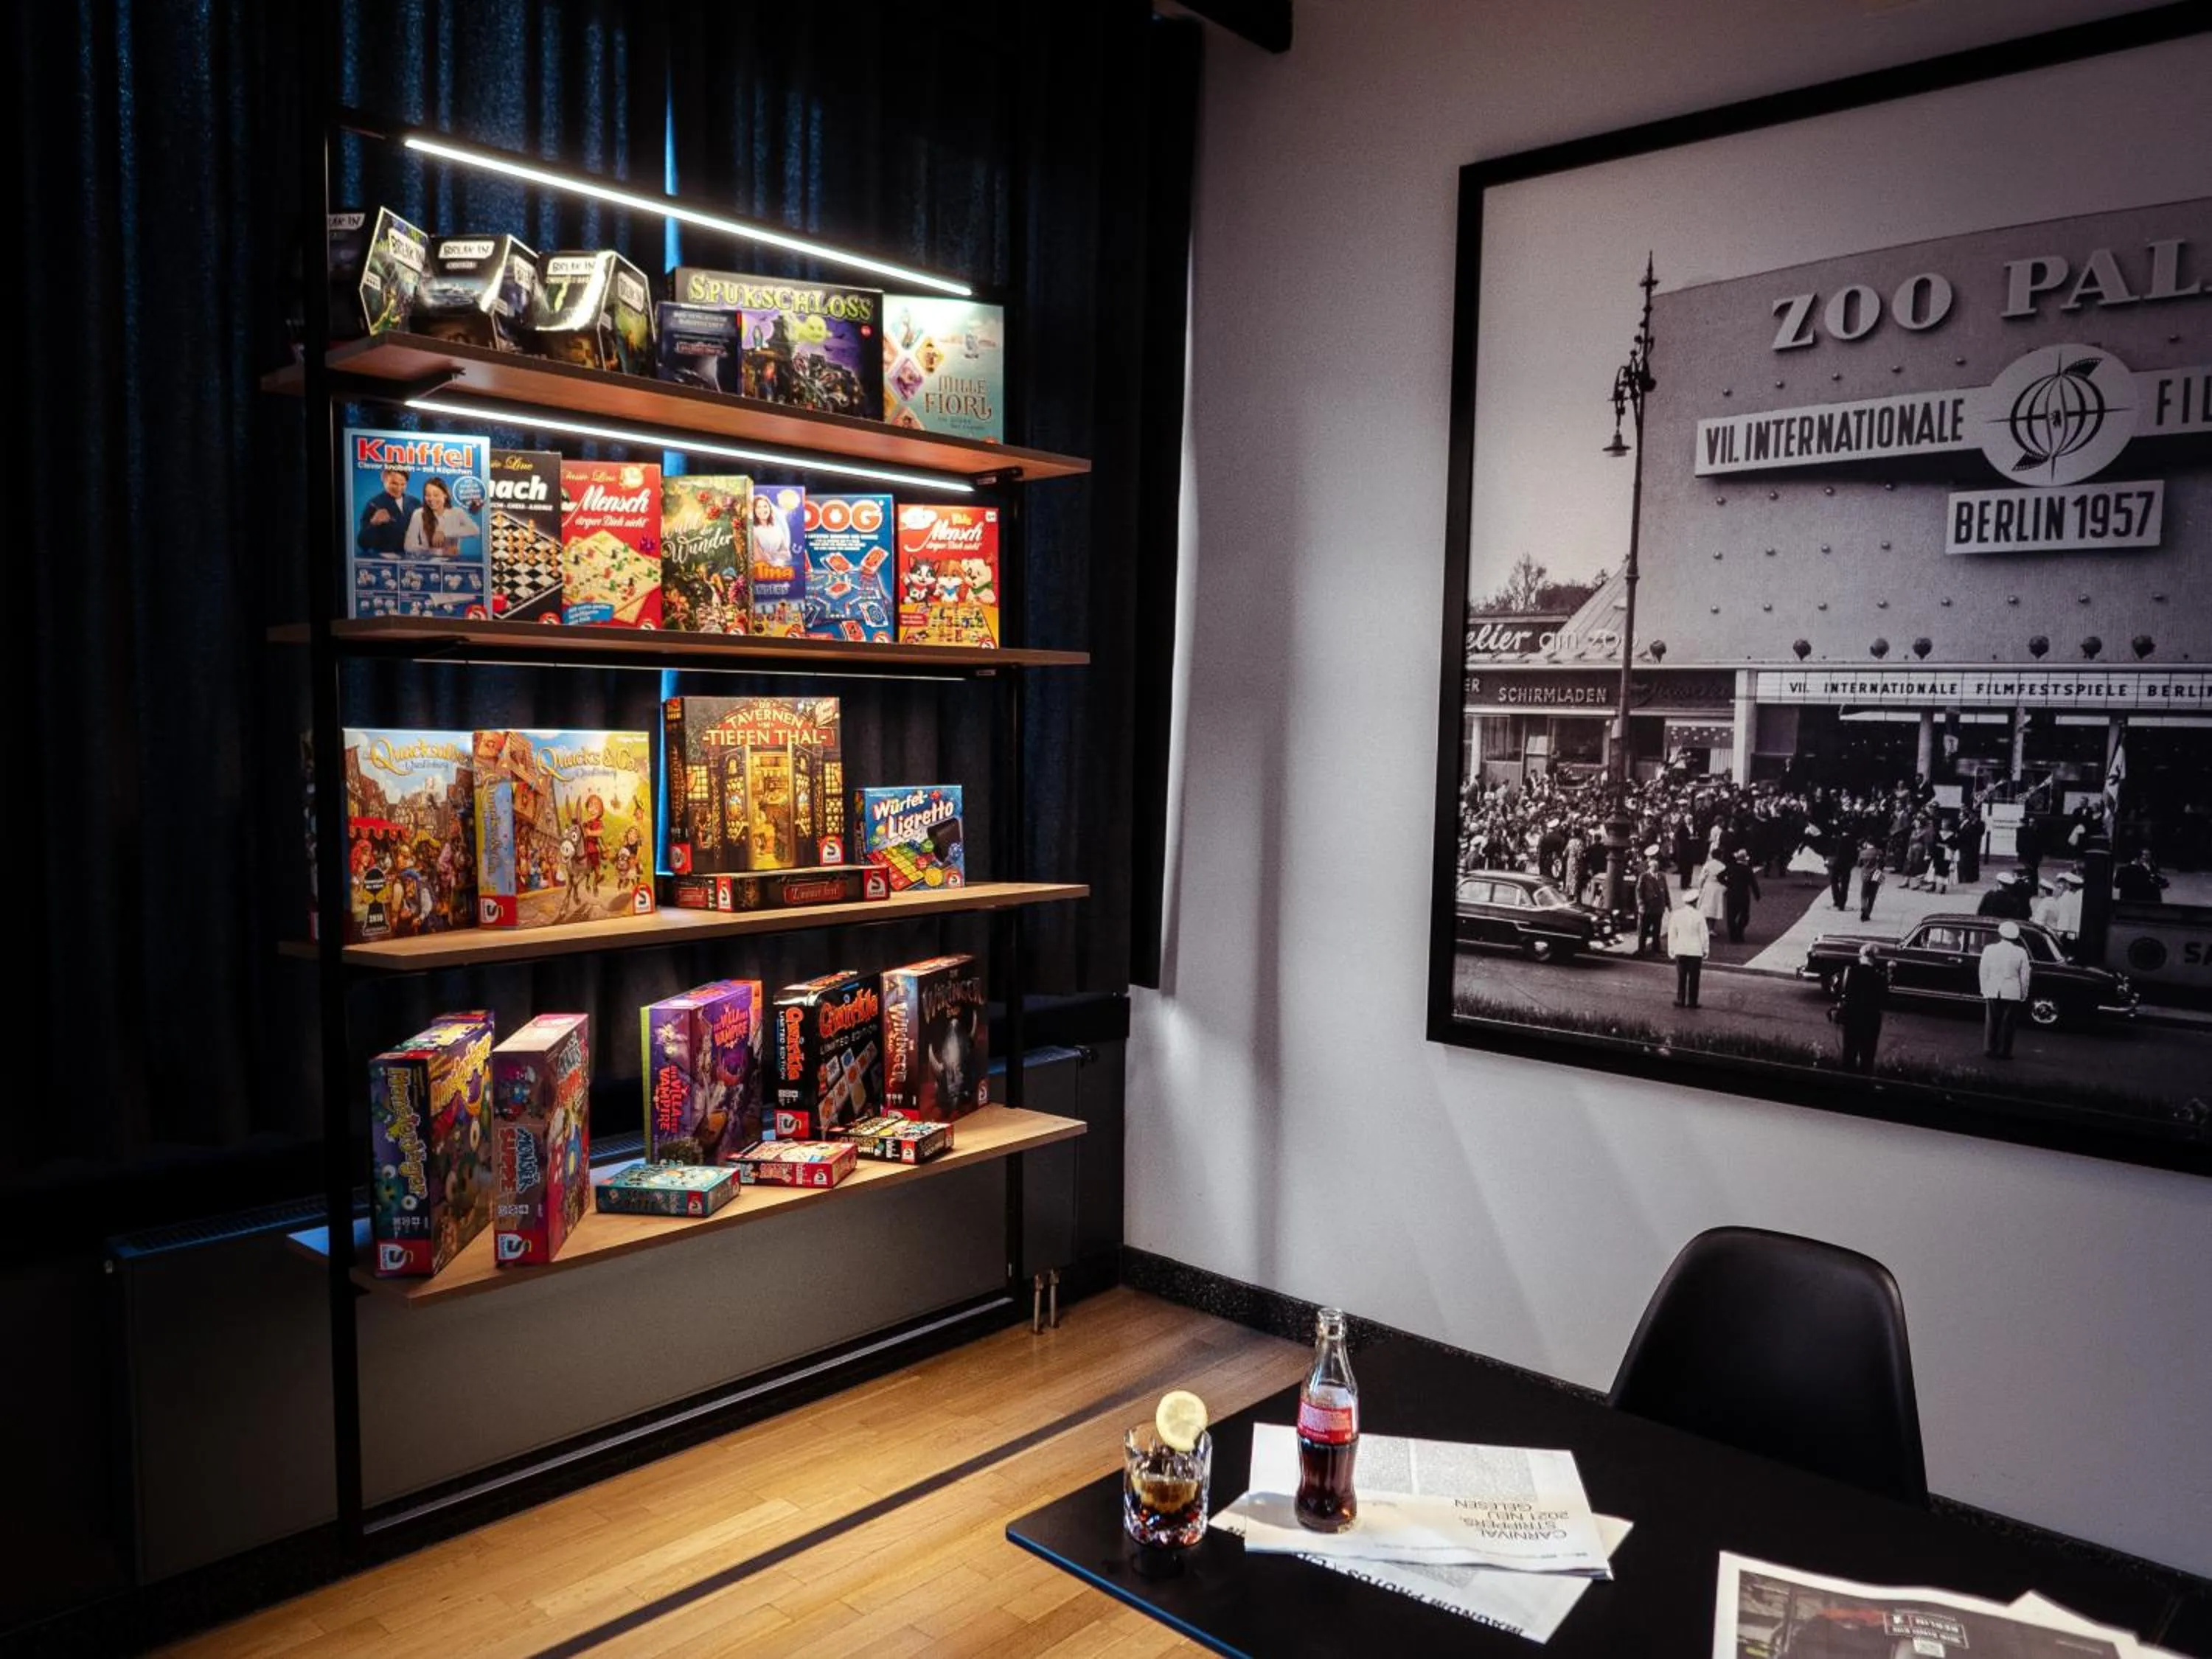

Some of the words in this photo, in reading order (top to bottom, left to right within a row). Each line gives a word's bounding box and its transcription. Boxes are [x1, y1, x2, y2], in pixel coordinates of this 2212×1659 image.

[1771, 272, 1954, 351] ZOO
[2001, 238, 2202, 319] PAL
[1705, 422, 1741, 466] VII.
[1744, 397, 1964, 462] INTERNATIONALE
[2156, 375, 2212, 425] FIL
[358, 437, 473, 468] Kniffel
[572, 484, 651, 516] Mensch
[804, 499, 883, 533] DOG
[1954, 497, 2066, 545] BERLIN
[2073, 491, 2155, 538] 1957
[661, 527, 734, 564] Wunder
[755, 562, 794, 582] Tina
[1498, 686, 1607, 704] SCHIRMLADEN
[1824, 682, 1958, 695] INTERNATIONALE
[1976, 683, 2127, 697] FILMFESTSPIELE
[726, 709, 804, 729] TAVERNEN
[887, 800, 954, 839] Ligretto
[658, 1067, 669, 1131] VAMPIRE
[1454, 1499, 1532, 1512] GELESEN
[1531, 1511, 1569, 1520] 2021
[1481, 1529, 1567, 1540] CARNIVAL
